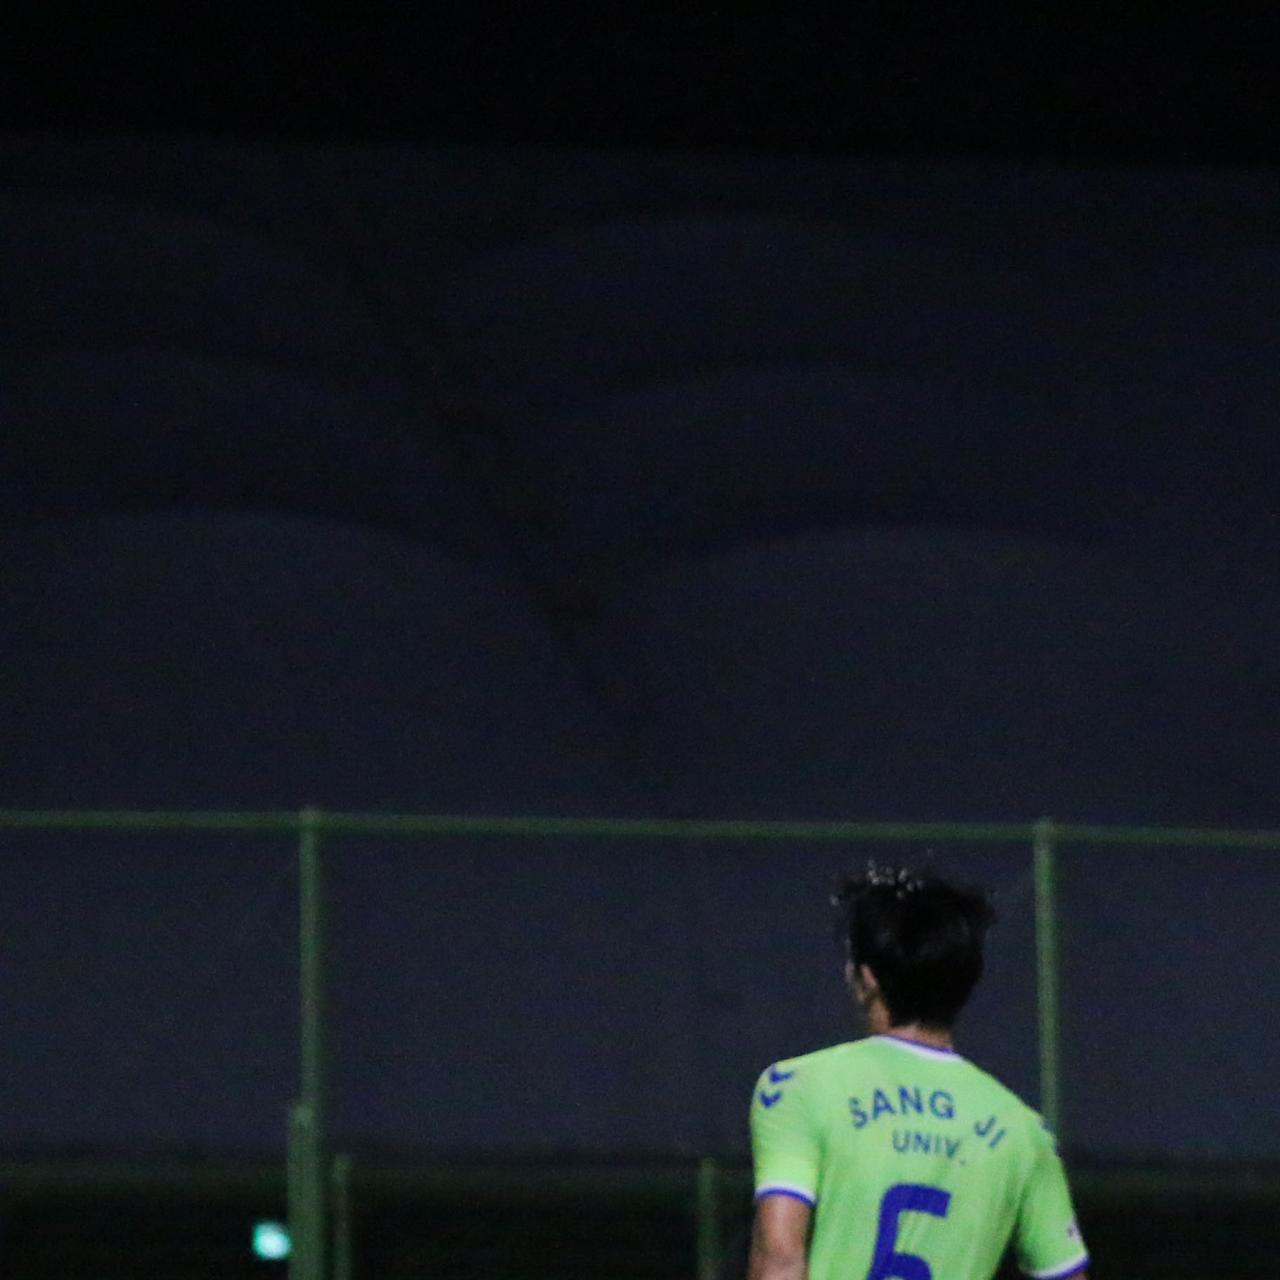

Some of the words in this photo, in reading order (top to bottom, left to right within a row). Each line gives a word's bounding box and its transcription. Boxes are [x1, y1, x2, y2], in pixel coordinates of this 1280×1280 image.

[848, 1084, 955, 1130] SANG
[974, 1114, 1007, 1149] JI
[892, 1129, 967, 1166] UNIV.
